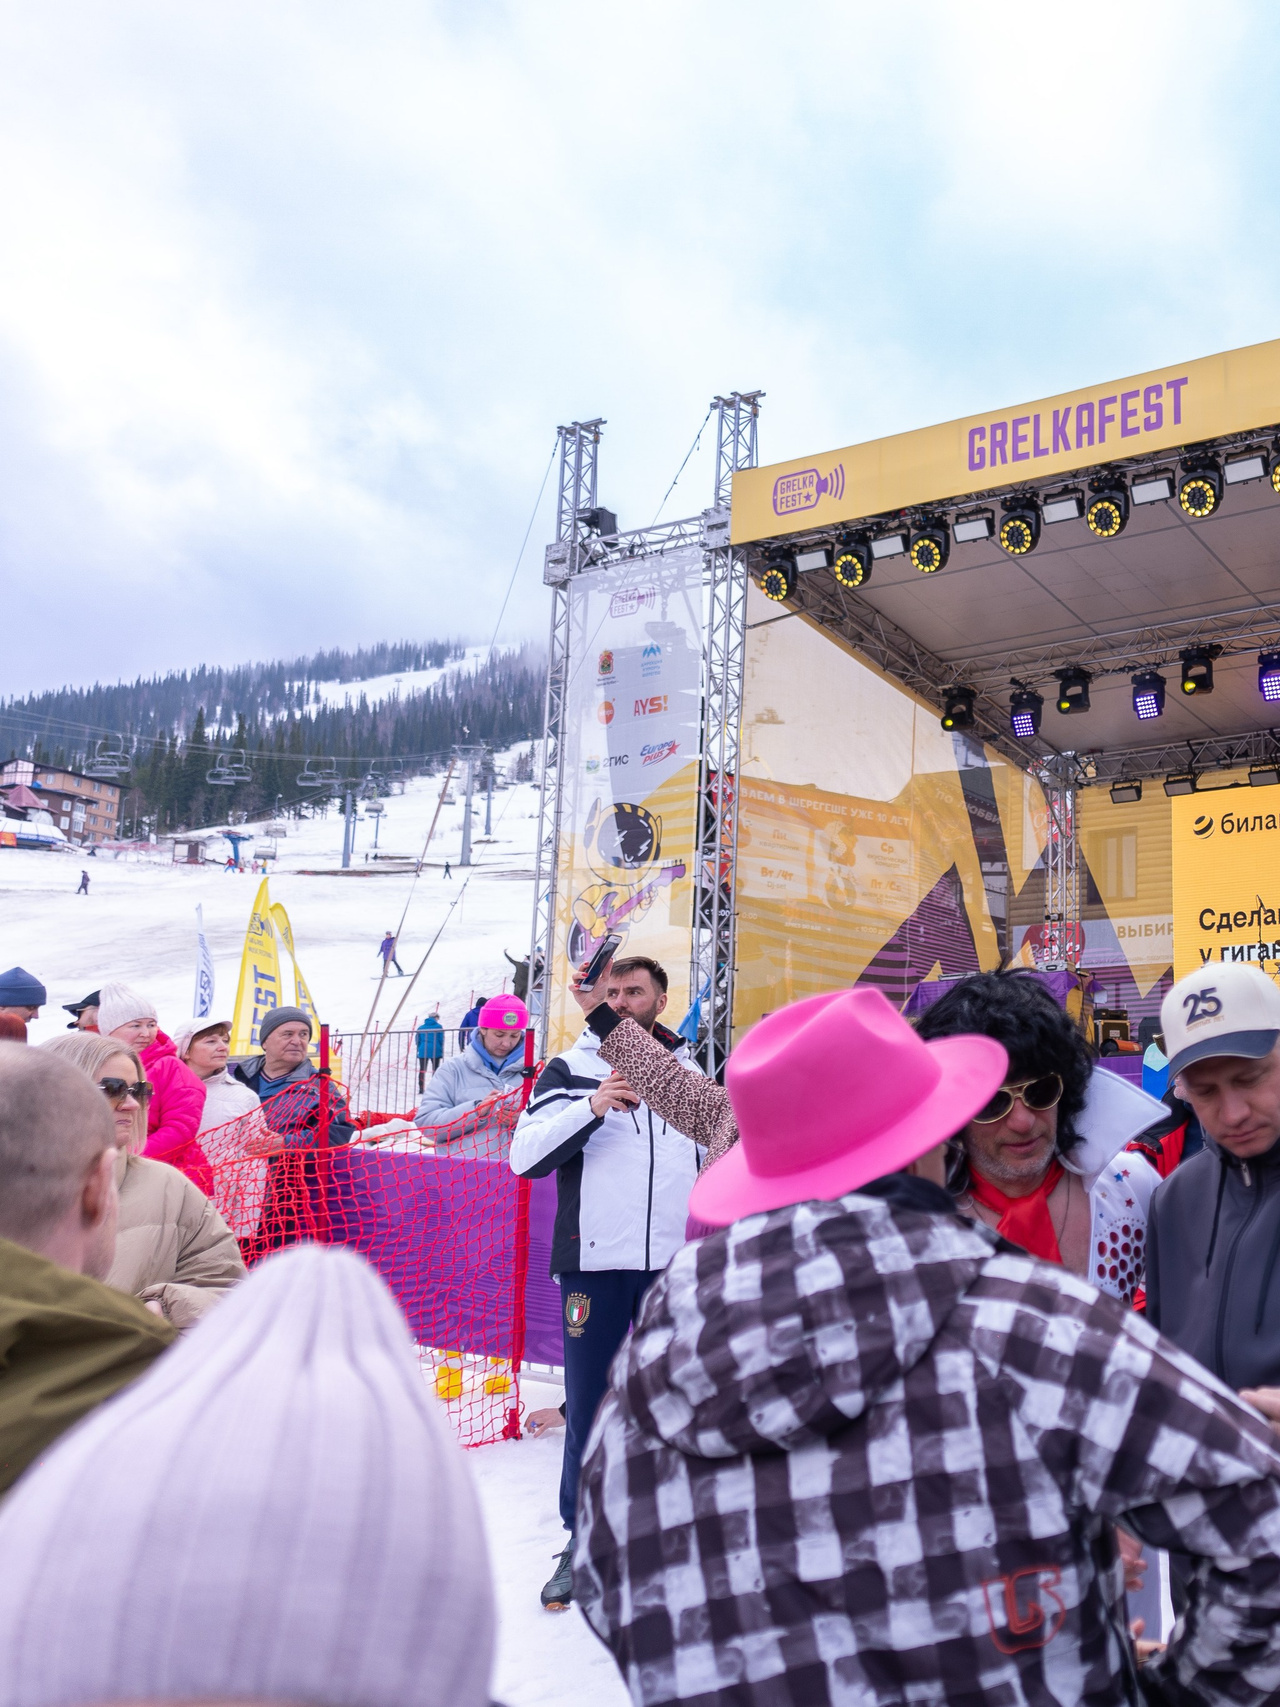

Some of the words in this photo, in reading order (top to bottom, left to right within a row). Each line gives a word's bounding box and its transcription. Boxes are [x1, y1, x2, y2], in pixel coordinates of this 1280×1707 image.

[967, 376, 1189, 472] GRELKAFEST
[780, 474, 814, 495] GRELKA
[780, 492, 803, 510] FEST
[614, 603, 629, 615] FEST
[633, 695, 669, 717] AYS!
[602, 754, 629, 768] 2ГИС
[778, 794, 786, 804] В
[789, 796, 848, 817] ШЕРЕГЕШЕ
[850, 807, 874, 820] УЖЕ
[876, 812, 888, 823] 10
[889, 815, 910, 827] ЛЕТ
[958, 800, 1001, 825] ЛЮБВИ
[880, 841, 895, 854] Ср
[760, 866, 774, 879] Вт
[1117, 922, 1173, 938] ВЫБИР
[1199, 947, 1213, 967] у
[1183, 987, 1222, 1026] 25
